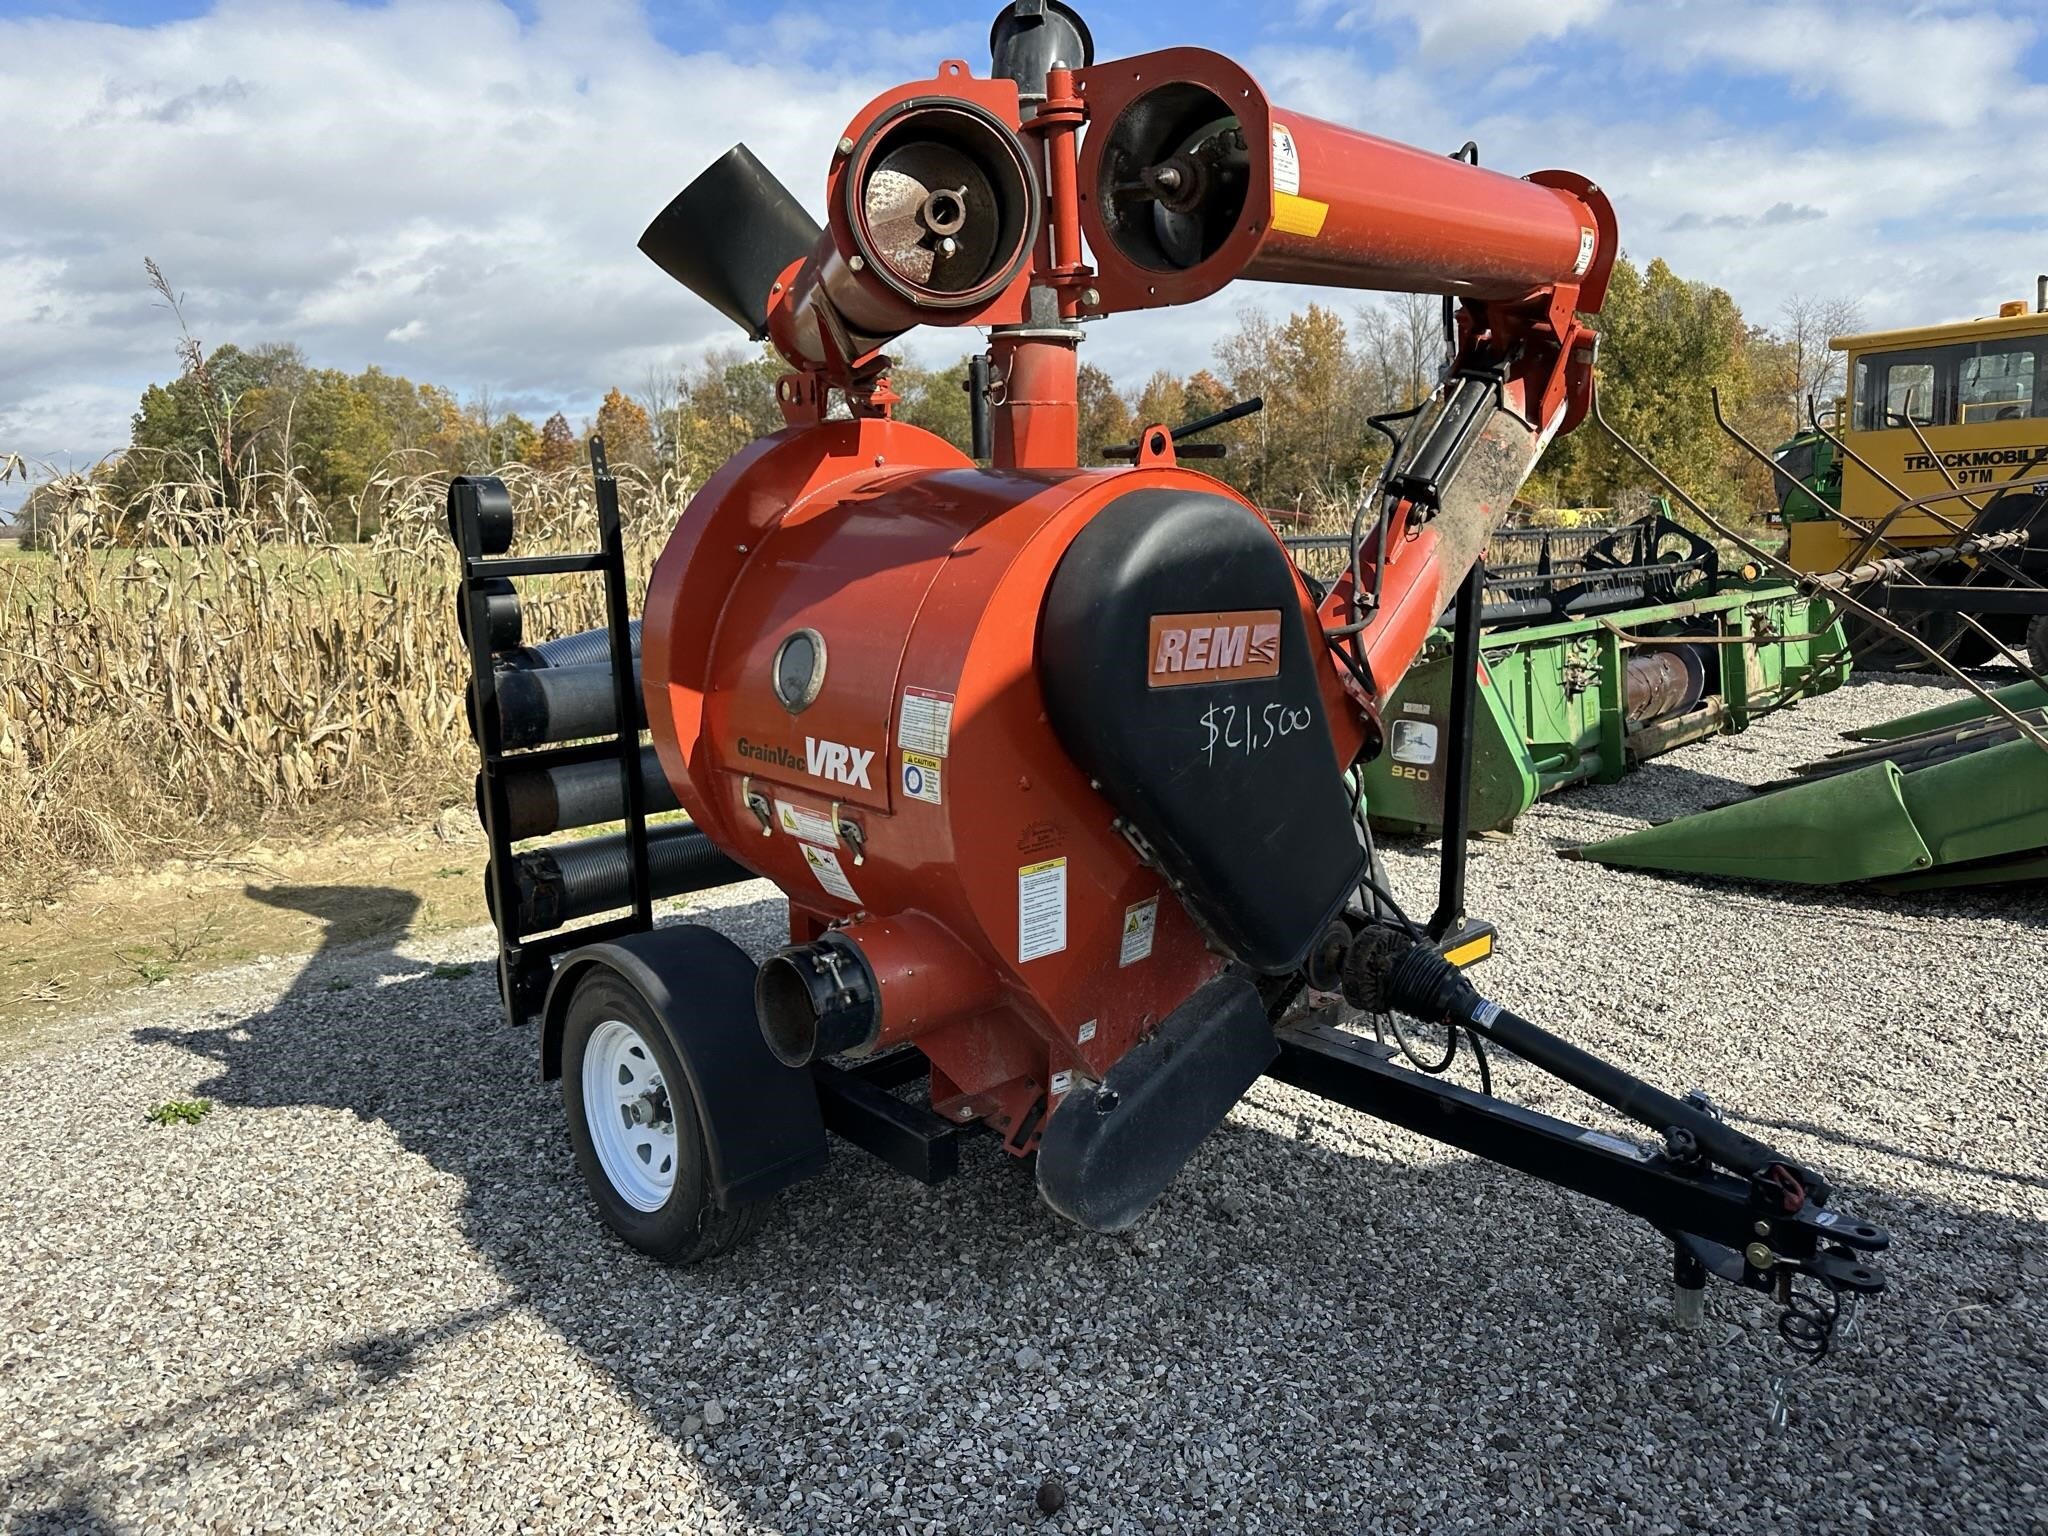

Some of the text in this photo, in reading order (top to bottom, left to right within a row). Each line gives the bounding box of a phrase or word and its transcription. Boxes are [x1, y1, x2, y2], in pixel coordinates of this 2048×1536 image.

[1958, 469, 1993, 484] 9TM
[1153, 625, 1249, 674] REM
[1200, 701, 1311, 768] $21,500
[737, 737, 806, 771] GrainVac
[805, 736, 875, 790] VRX
[914, 755, 937, 768] CAUTION
[1391, 765, 1430, 781] 920
